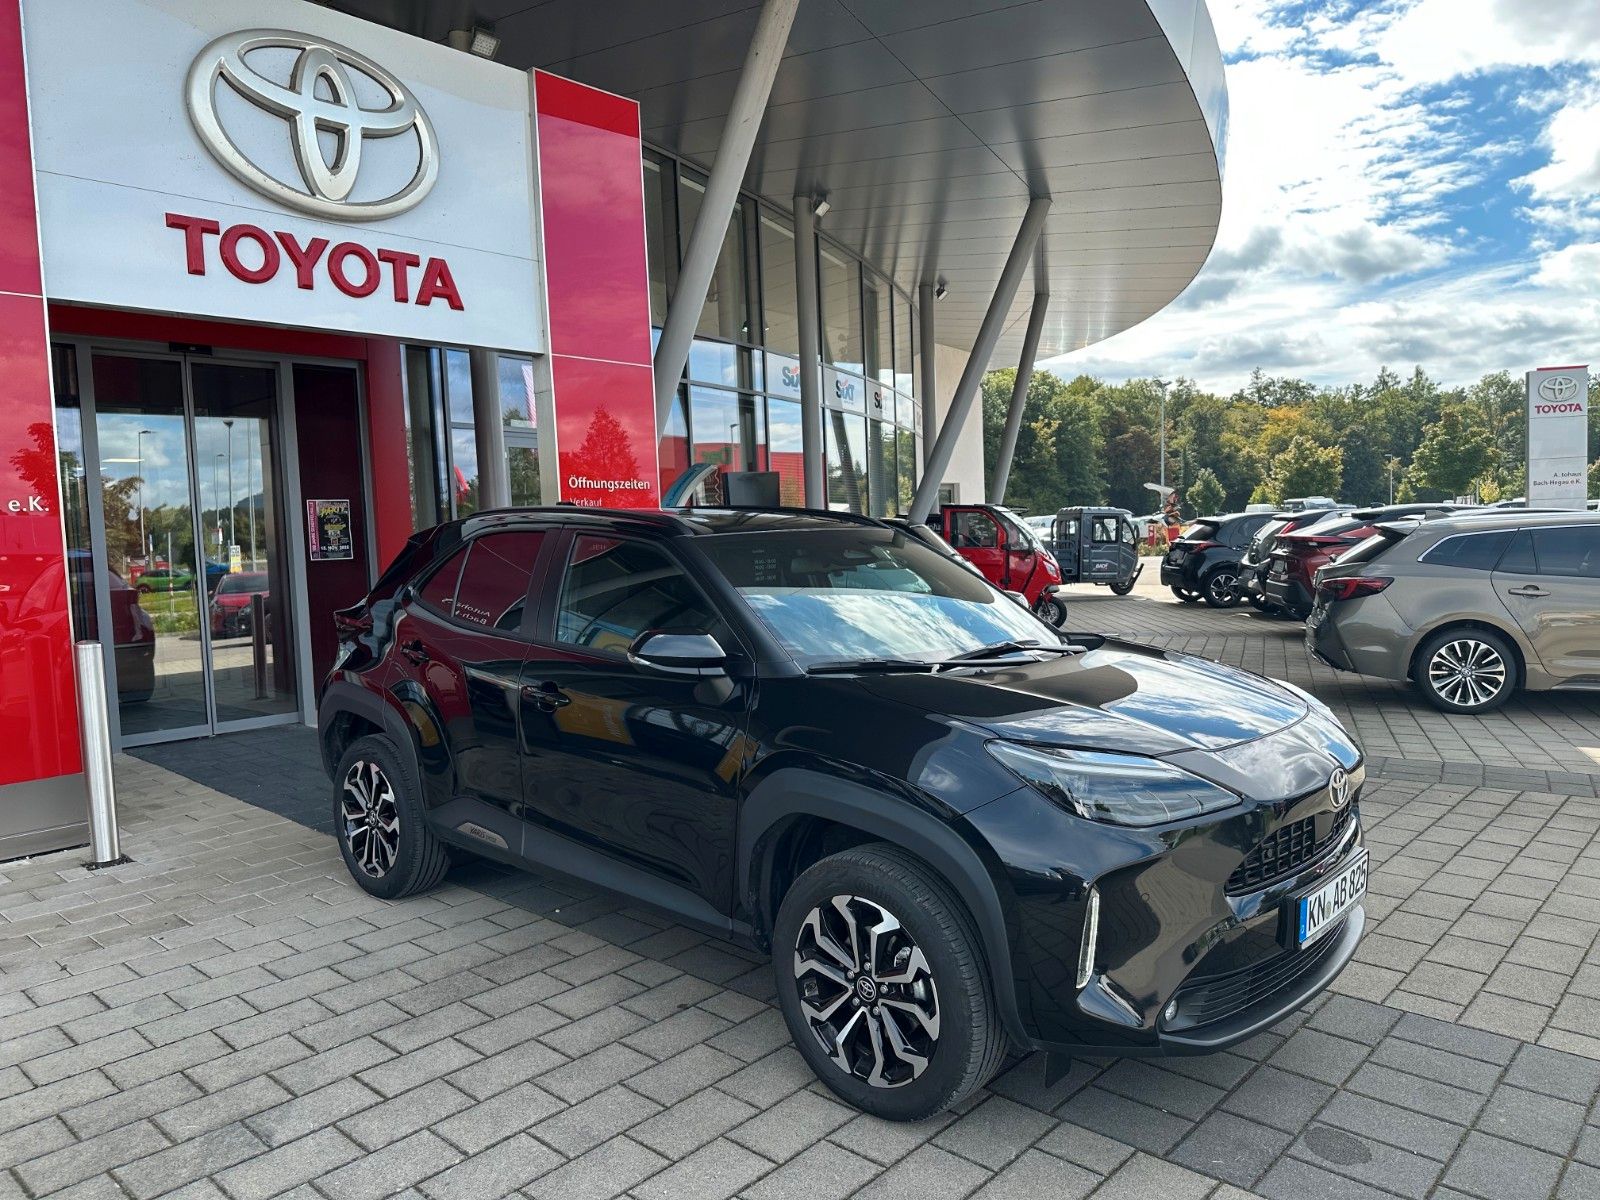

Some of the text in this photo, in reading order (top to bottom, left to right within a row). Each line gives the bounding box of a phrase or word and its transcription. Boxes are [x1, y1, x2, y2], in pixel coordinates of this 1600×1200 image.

[165, 212, 464, 311] TOYOTA
[1535, 403, 1583, 414] TOYOTA
[568, 475, 650, 492] Öffnungszeiten
[8, 495, 50, 512] e.K.
[1308, 859, 1367, 931] KN AB 825
